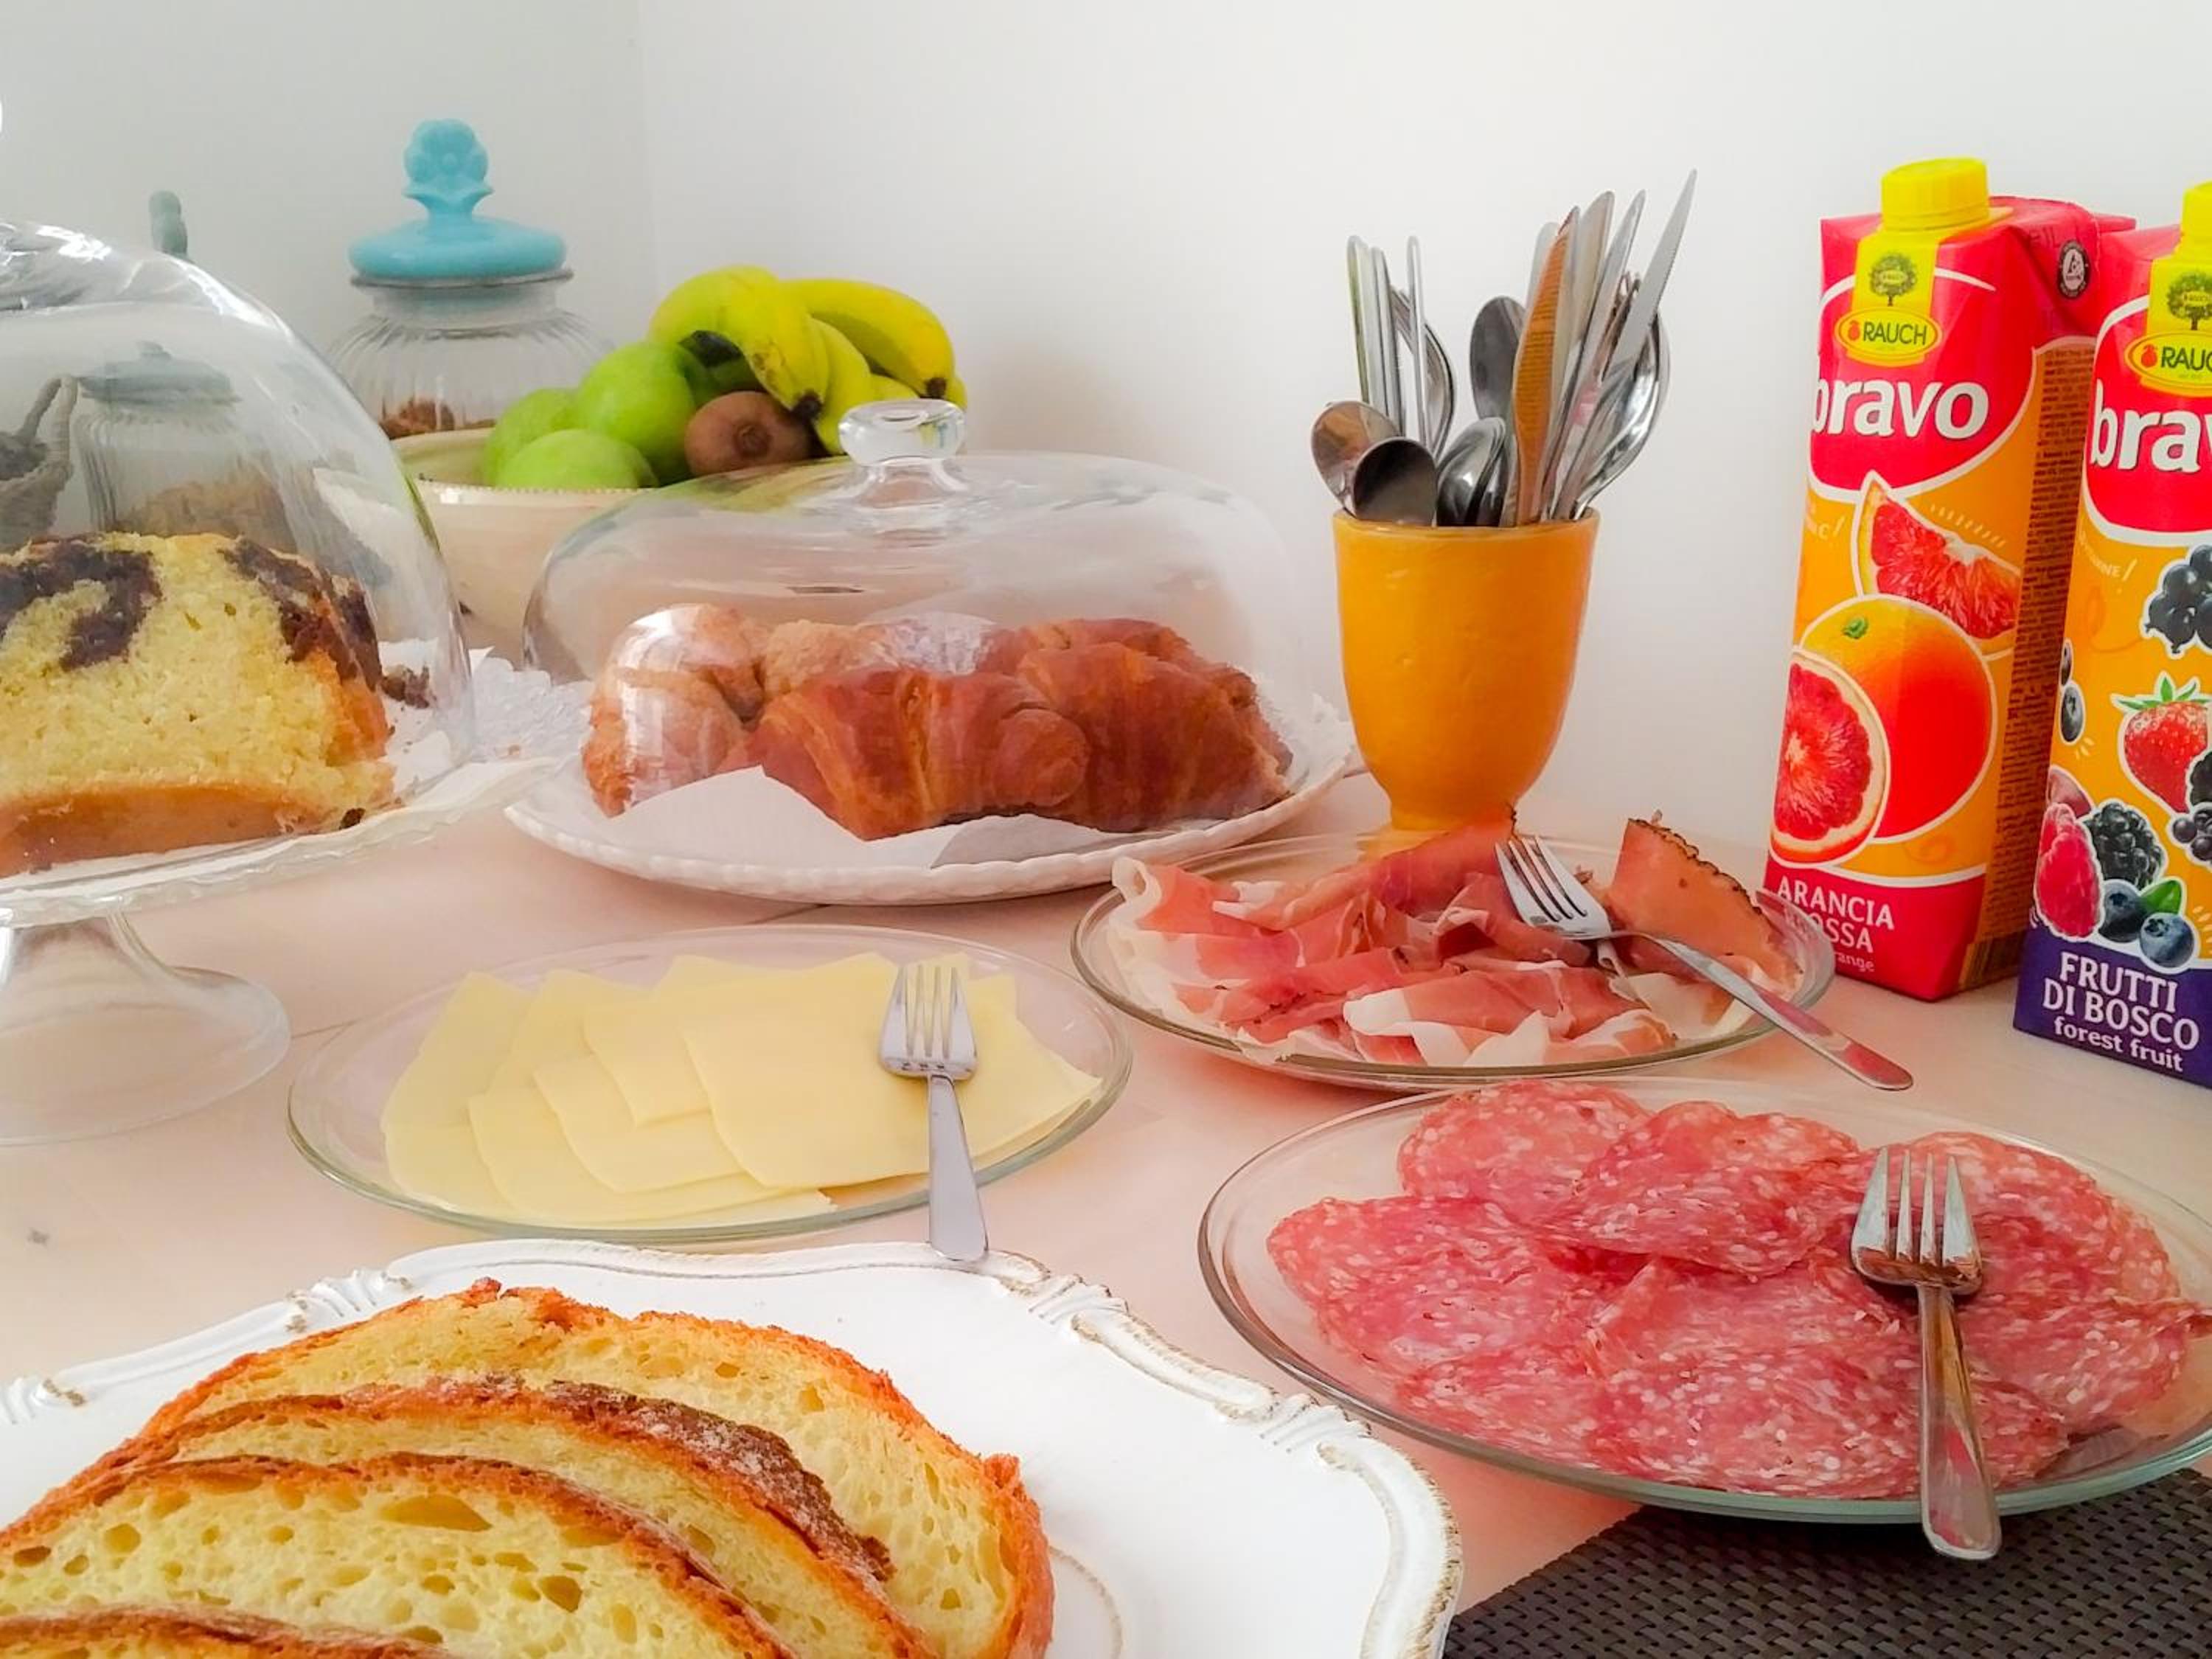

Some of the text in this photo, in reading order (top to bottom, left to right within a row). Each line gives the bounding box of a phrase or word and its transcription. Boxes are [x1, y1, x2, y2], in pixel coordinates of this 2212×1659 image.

[1863, 321, 1927, 346] RAUCH
[2089, 378, 2212, 473] bra
[1778, 875, 1895, 931] ARANCIA
[1787, 909, 1874, 953] OSSA
[2059, 951, 2178, 1013] FRUTTI
[2042, 977, 2199, 1051] DI BOSCO
[2054, 1016, 2183, 1072] forest fruit
